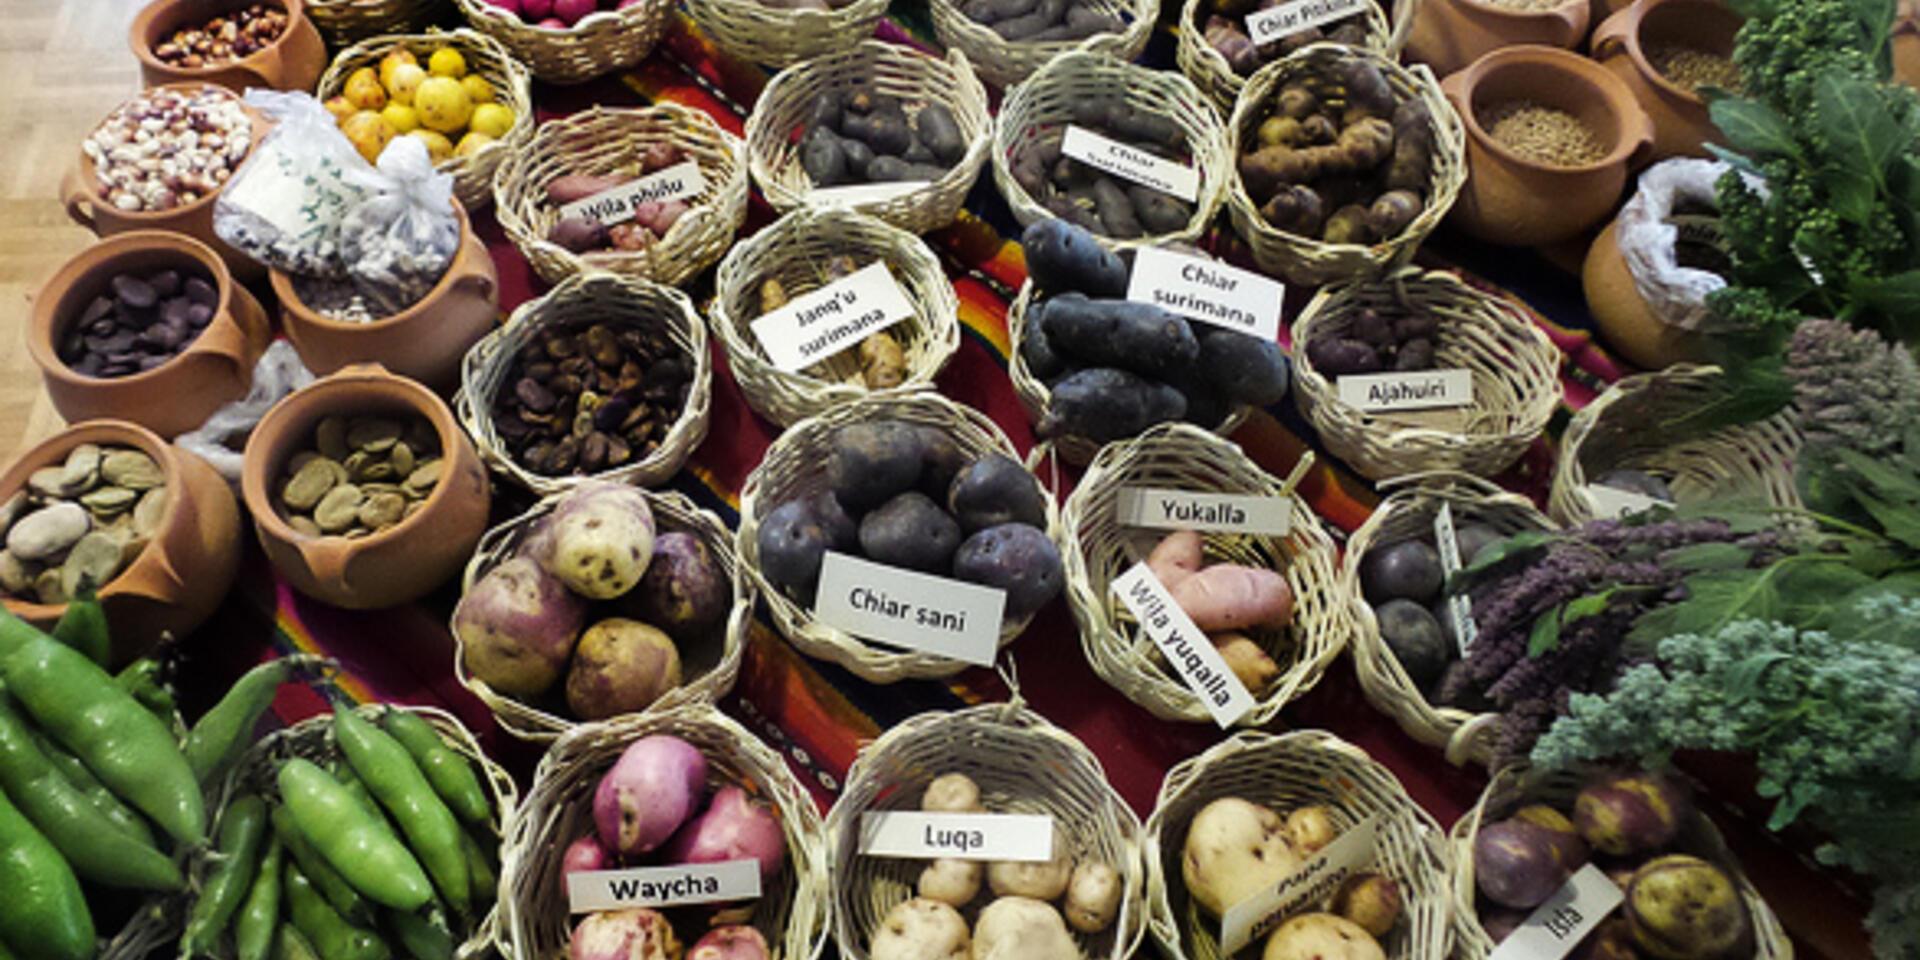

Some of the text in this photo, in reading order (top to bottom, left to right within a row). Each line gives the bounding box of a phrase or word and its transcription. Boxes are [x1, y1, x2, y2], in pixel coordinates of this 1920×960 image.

[1258, 12, 1297, 36] Chiar
[1109, 145, 1155, 168] Chiar
[580, 198, 626, 219] Wila
[1181, 262, 1239, 292] Chiar
[1153, 288, 1256, 327] surimana
[799, 308, 886, 357] surimana
[1368, 379, 1446, 405] Ajahuiri
[1162, 500, 1246, 525] Yukalla
[850, 587, 967, 633] Chiar sani
[1129, 578, 1233, 708] Wila yuqalla
[923, 824, 984, 853] Luqa
[609, 874, 719, 902] Waycha
[1543, 906, 1584, 940] Isla
